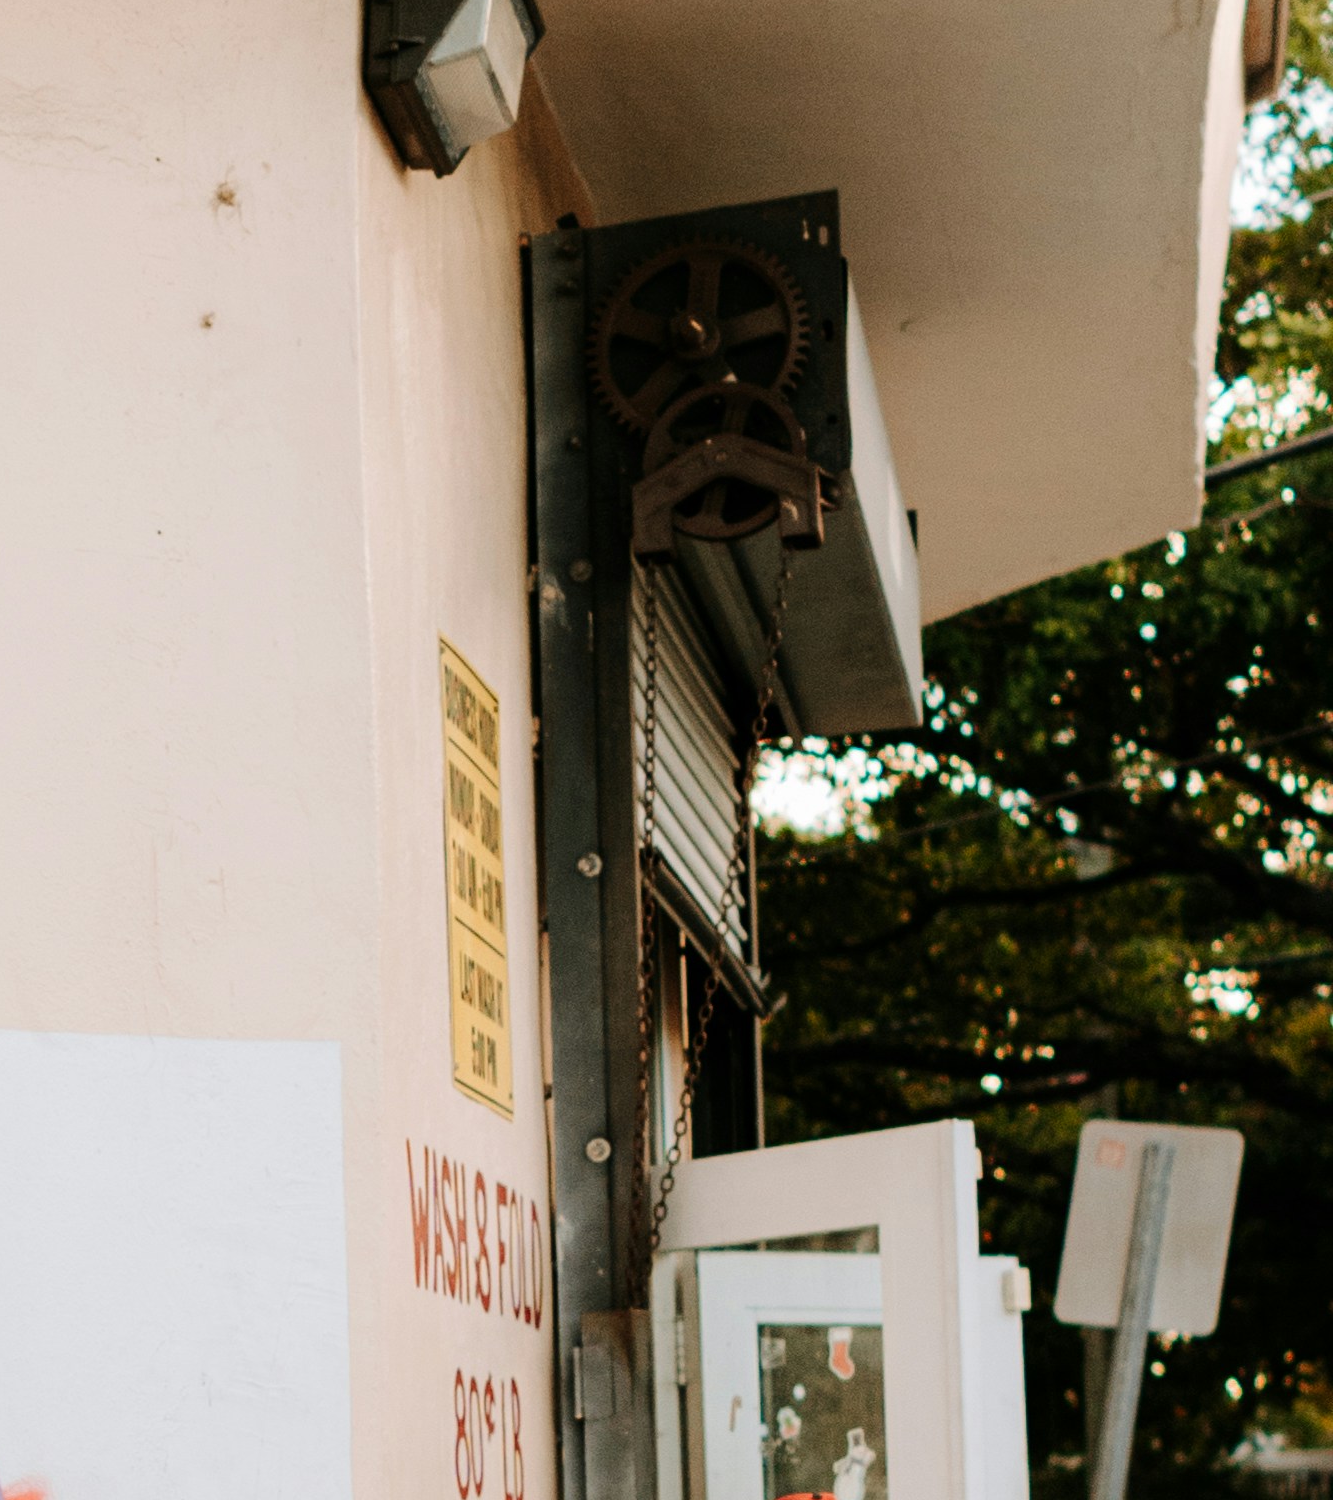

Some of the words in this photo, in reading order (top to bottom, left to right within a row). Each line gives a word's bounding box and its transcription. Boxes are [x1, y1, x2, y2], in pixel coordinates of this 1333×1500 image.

[444, 664, 477, 745] BUSINESS
[448, 759, 475, 835] MONDAY
[480, 791, 500, 861] SUNDAY
[468, 850, 477, 909] AM
[495, 879, 503, 932] PM
[460, 951, 476, 1010] LAST
[478, 964, 495, 1021] WASH
[471, 1025, 485, 1079] 5:00
[487, 1035, 497, 1086] PM
[406, 1138, 471, 1304] WASH
[496, 1181, 544, 1330] FOLD
